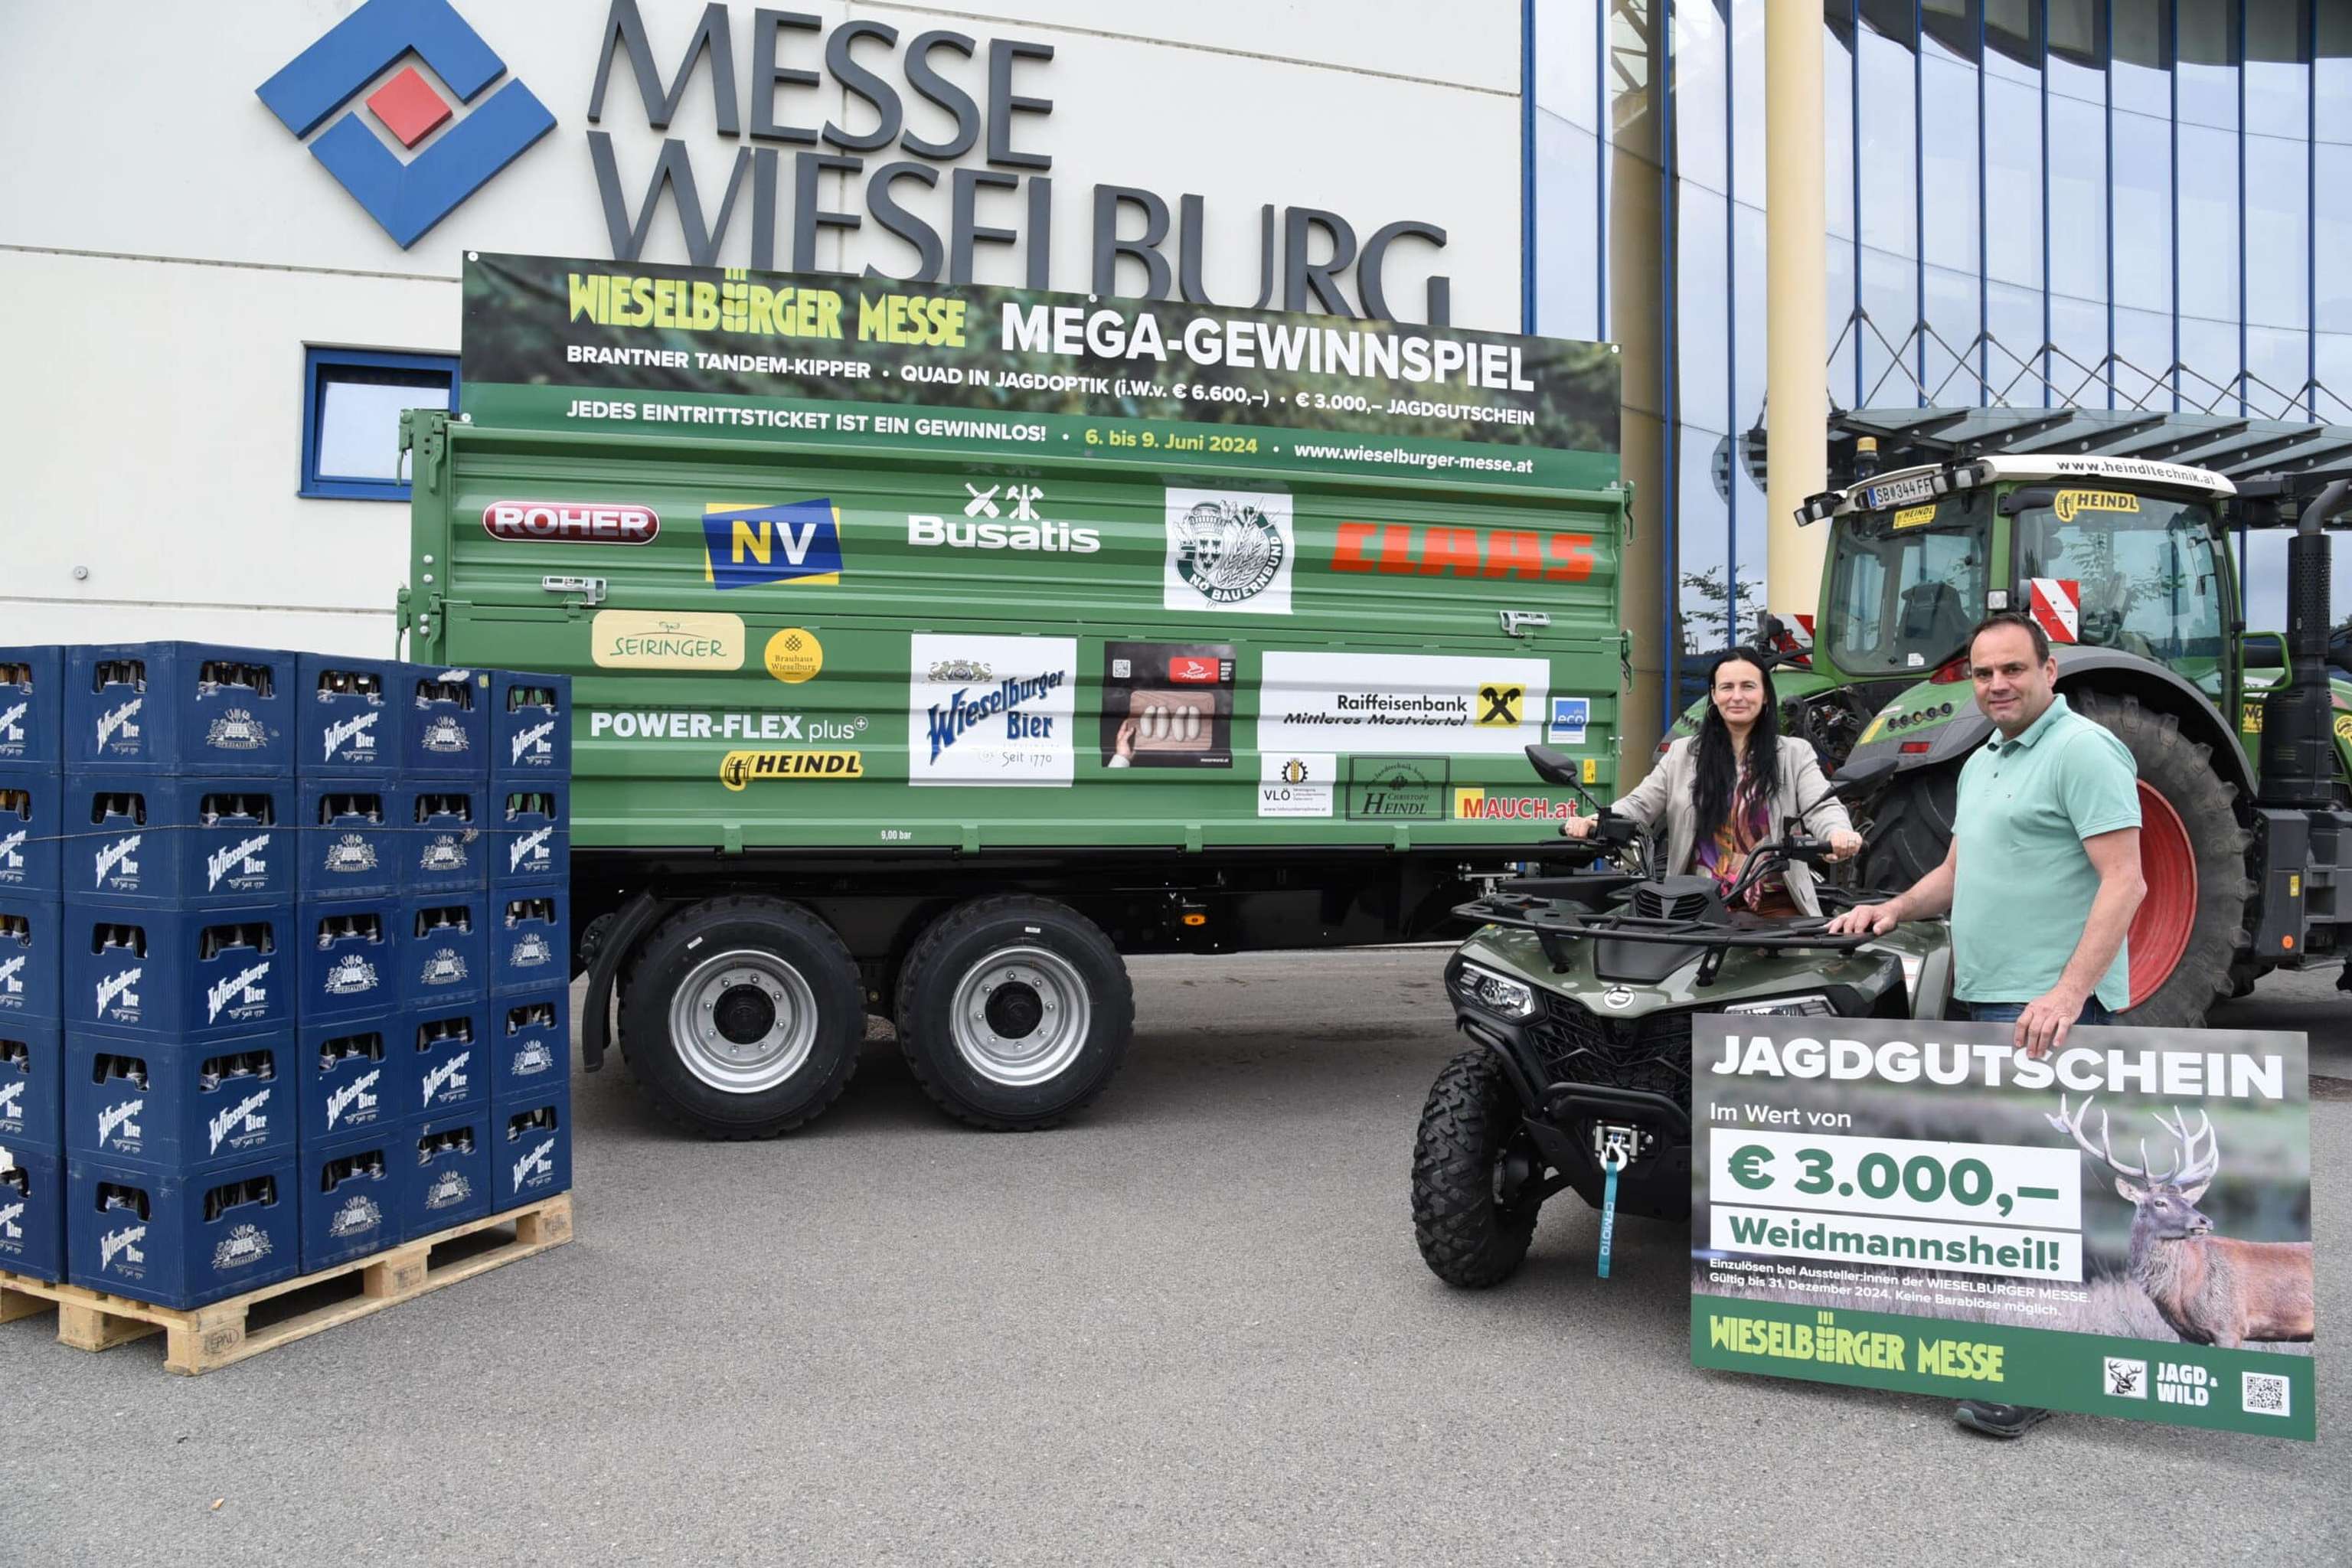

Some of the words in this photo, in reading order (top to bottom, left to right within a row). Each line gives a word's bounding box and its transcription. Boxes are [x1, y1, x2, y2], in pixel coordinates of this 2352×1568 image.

[587, 0, 1055, 170] MESSE
[586, 130, 1451, 327] WIESELBURG
[859, 293, 965, 348] MESSE
[1001, 302, 1534, 392] MEGA-GEWINNSPIEL
[567, 345, 689, 369] BRANTNER
[694, 352, 871, 378] TANDEM-KIPPER
[900, 365, 964, 387] QUAD
[969, 370, 990, 387] IN
[995, 371, 1109, 395] JAGDOPTIK
[1172, 383, 1187, 400] €
[1295, 391, 1310, 408] €
[1387, 399, 1535, 426] JAGDGUTSCHEIN
[567, 400, 637, 420] JEDES
[642, 403, 830, 430] EINTRITTSTICKET
[835, 413, 869, 433] IST
[874, 416, 910, 434] EIN
[914, 418, 1047, 443] GEWINNLOS!
[1085, 429, 1105, 446] 6.
[1109, 430, 1137, 447] bis
[1141, 432, 1160, 449] 9.
[1164, 433, 1205, 452] Juni
[1210, 436, 1258, 454] 2024
[1294, 442, 1534, 475] www.wieselburger-messe.at
[2057, 461, 2216, 486] www.heindltechnik.at
[1875, 487, 1890, 504] SB
[2076, 493, 2138, 510] HEINDL
[495, 506, 652, 537] ROHER
[907, 514, 1101, 554] Busatis
[731, 520, 818, 566] NV
[1329, 521, 1595, 582] CLAAS
[1211, 536, 1283, 602] BAUERNBUND
[609, 636, 727, 658] SEIRINGER
[771, 663, 817, 672] Wieselburg
[926, 669, 1066, 766] Wieselburger
[1337, 694, 1468, 713] Raiffeisenbank
[590, 712, 803, 740] POWER-FLEX
[808, 720, 855, 743] plus
[1006, 710, 1054, 740] Bier
[1283, 711, 1364, 726] Mittleres
[1367, 713, 1467, 727] Mostviertel
[1557, 714, 1584, 724] eco
[754, 754, 861, 774] HEINDL
[1001, 752, 1024, 767] Seit
[1030, 753, 1053, 767] 1770
[1263, 788, 1291, 801] VLÖ
[1360, 792, 1428, 815] HEINDL
[1462, 797, 1578, 820] MAUCH.at
[899, 830, 912, 840] bar
[207, 834, 270, 892] Wieselburger
[244, 856, 266, 874] Bier
[207, 962, 270, 1024] Wieselburger
[244, 985, 266, 1004] Bier
[1711, 1034, 2284, 1099] JAGDGUTSCHEIN
[358, 1093, 377, 1109] Bier
[1710, 1102, 1737, 1121] Im
[1745, 1105, 1802, 1127] Wert
[1807, 1111, 1852, 1129] von
[245, 1113, 266, 1132] Bier
[1727, 1145, 1775, 1191] €
[1729, 1215, 2060, 1272] Weidmannsheil!
[1710, 1259, 1775, 1273] Einzulösen
[1777, 1262, 1797, 1276] bei
[1798, 1266, 1900, 1286] Aussteller:innen
[1901, 1275, 1925, 1288] der
[1926, 1277, 2036, 1299] WIESELBURGER
[2039, 1288, 2092, 1304] MESSE.
[1710, 1272, 1745, 1287] Gültig
[1748, 1274, 1766, 1289] bis
[1768, 1277, 1785, 1289] 31.
[1788, 1279, 1852, 1296] Dezember
[1854, 1285, 1893, 1300] 2024.
[1895, 1289, 1932, 1304] Keine
[1935, 1292, 2001, 1311] Barablöse
[2004, 1299, 2063, 1317] möglich.
[1917, 1336, 2004, 1383] MESSE
[2156, 1361, 2208, 1386] JAGD
[2209, 1377, 2219, 1388] &
[2156, 1382, 2210, 1406] WILD
